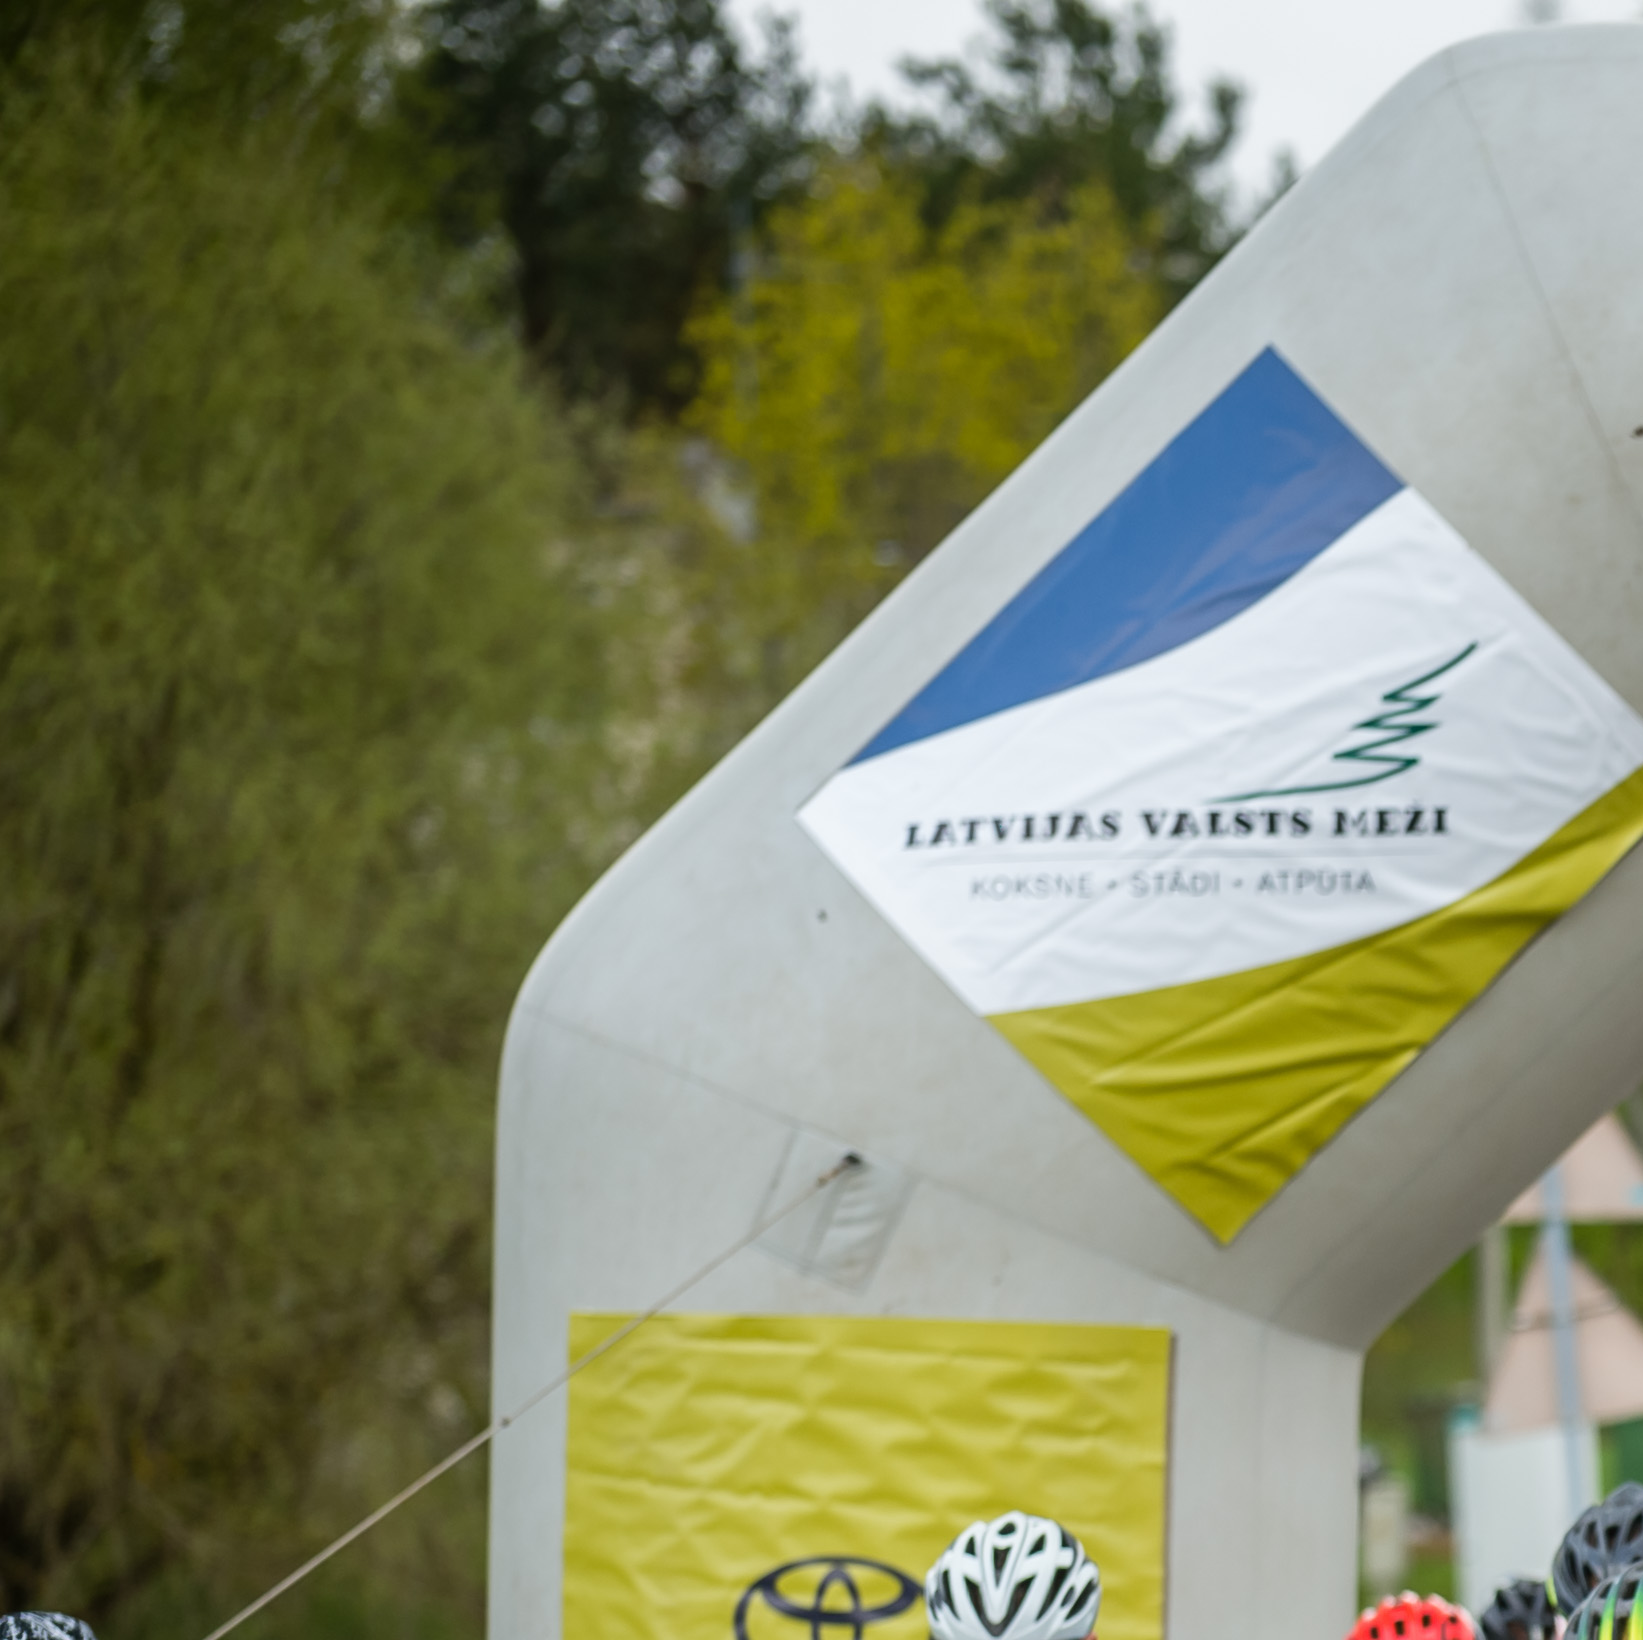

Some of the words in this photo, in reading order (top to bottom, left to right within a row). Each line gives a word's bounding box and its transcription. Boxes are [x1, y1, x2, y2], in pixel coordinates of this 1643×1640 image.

[905, 811, 1121, 849] LATVIJAS
[1142, 808, 1311, 840] VALSTS
[1334, 803, 1449, 836] MEŽI
[970, 872, 1093, 899] KOKSNE
[1256, 867, 1374, 896] ATPŪTA
